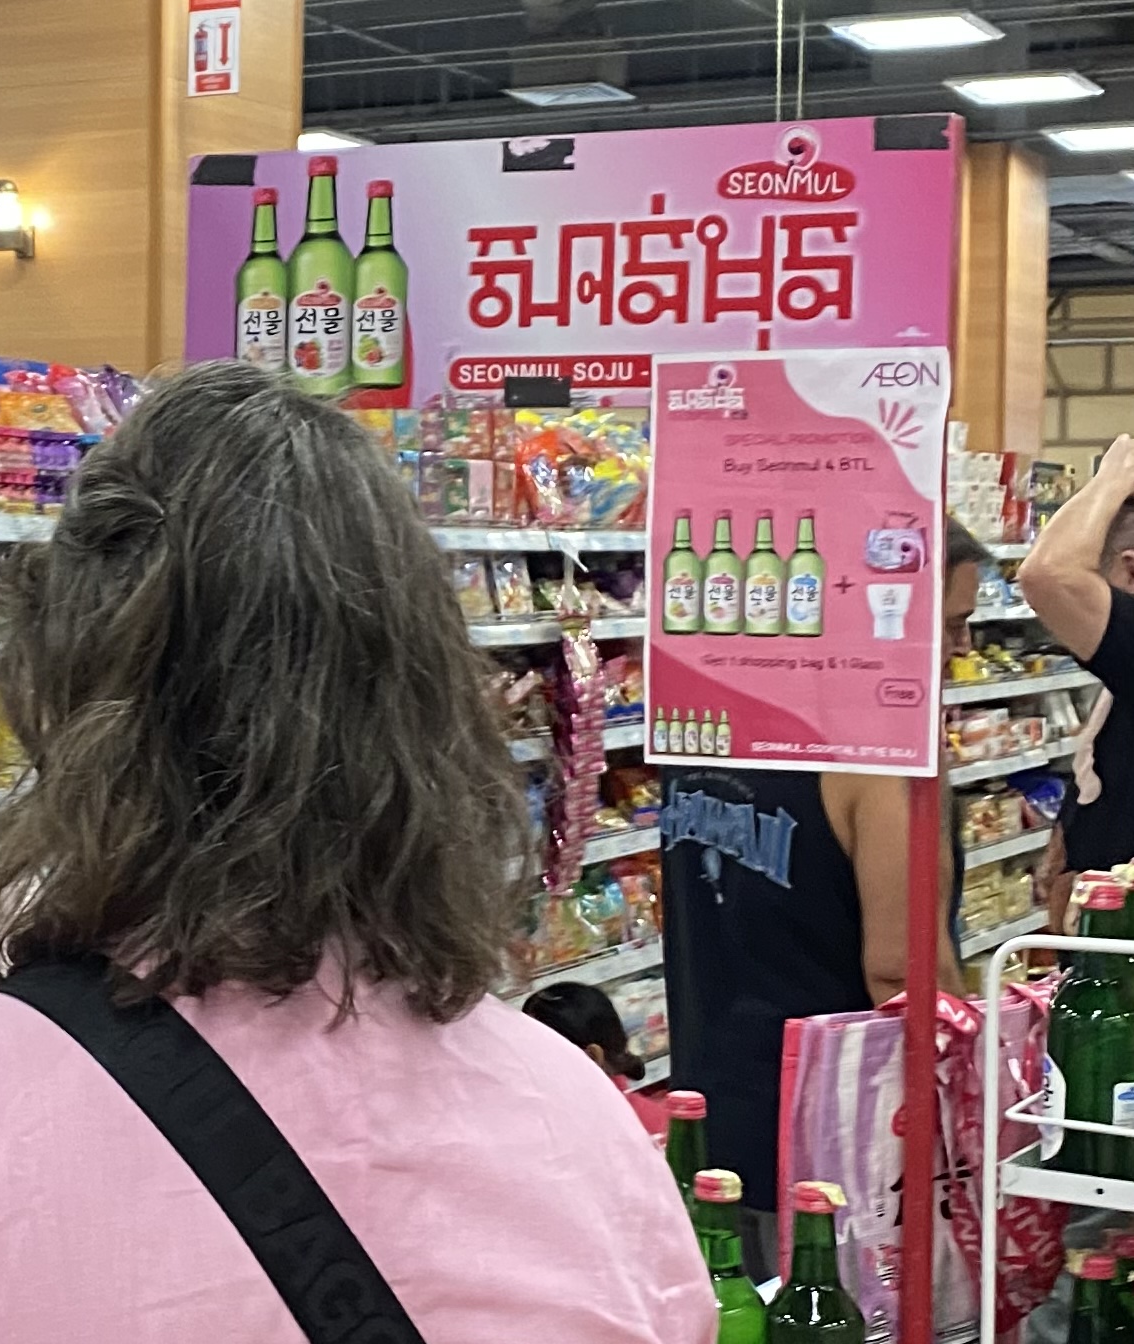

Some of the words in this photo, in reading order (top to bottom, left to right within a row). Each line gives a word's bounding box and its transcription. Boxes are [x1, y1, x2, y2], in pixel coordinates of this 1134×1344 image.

[726, 167, 848, 196] SEONMUL
[573, 361, 633, 382] SOJU
[723, 458, 753, 475] Buy
[839, 457, 875, 471] BTL
